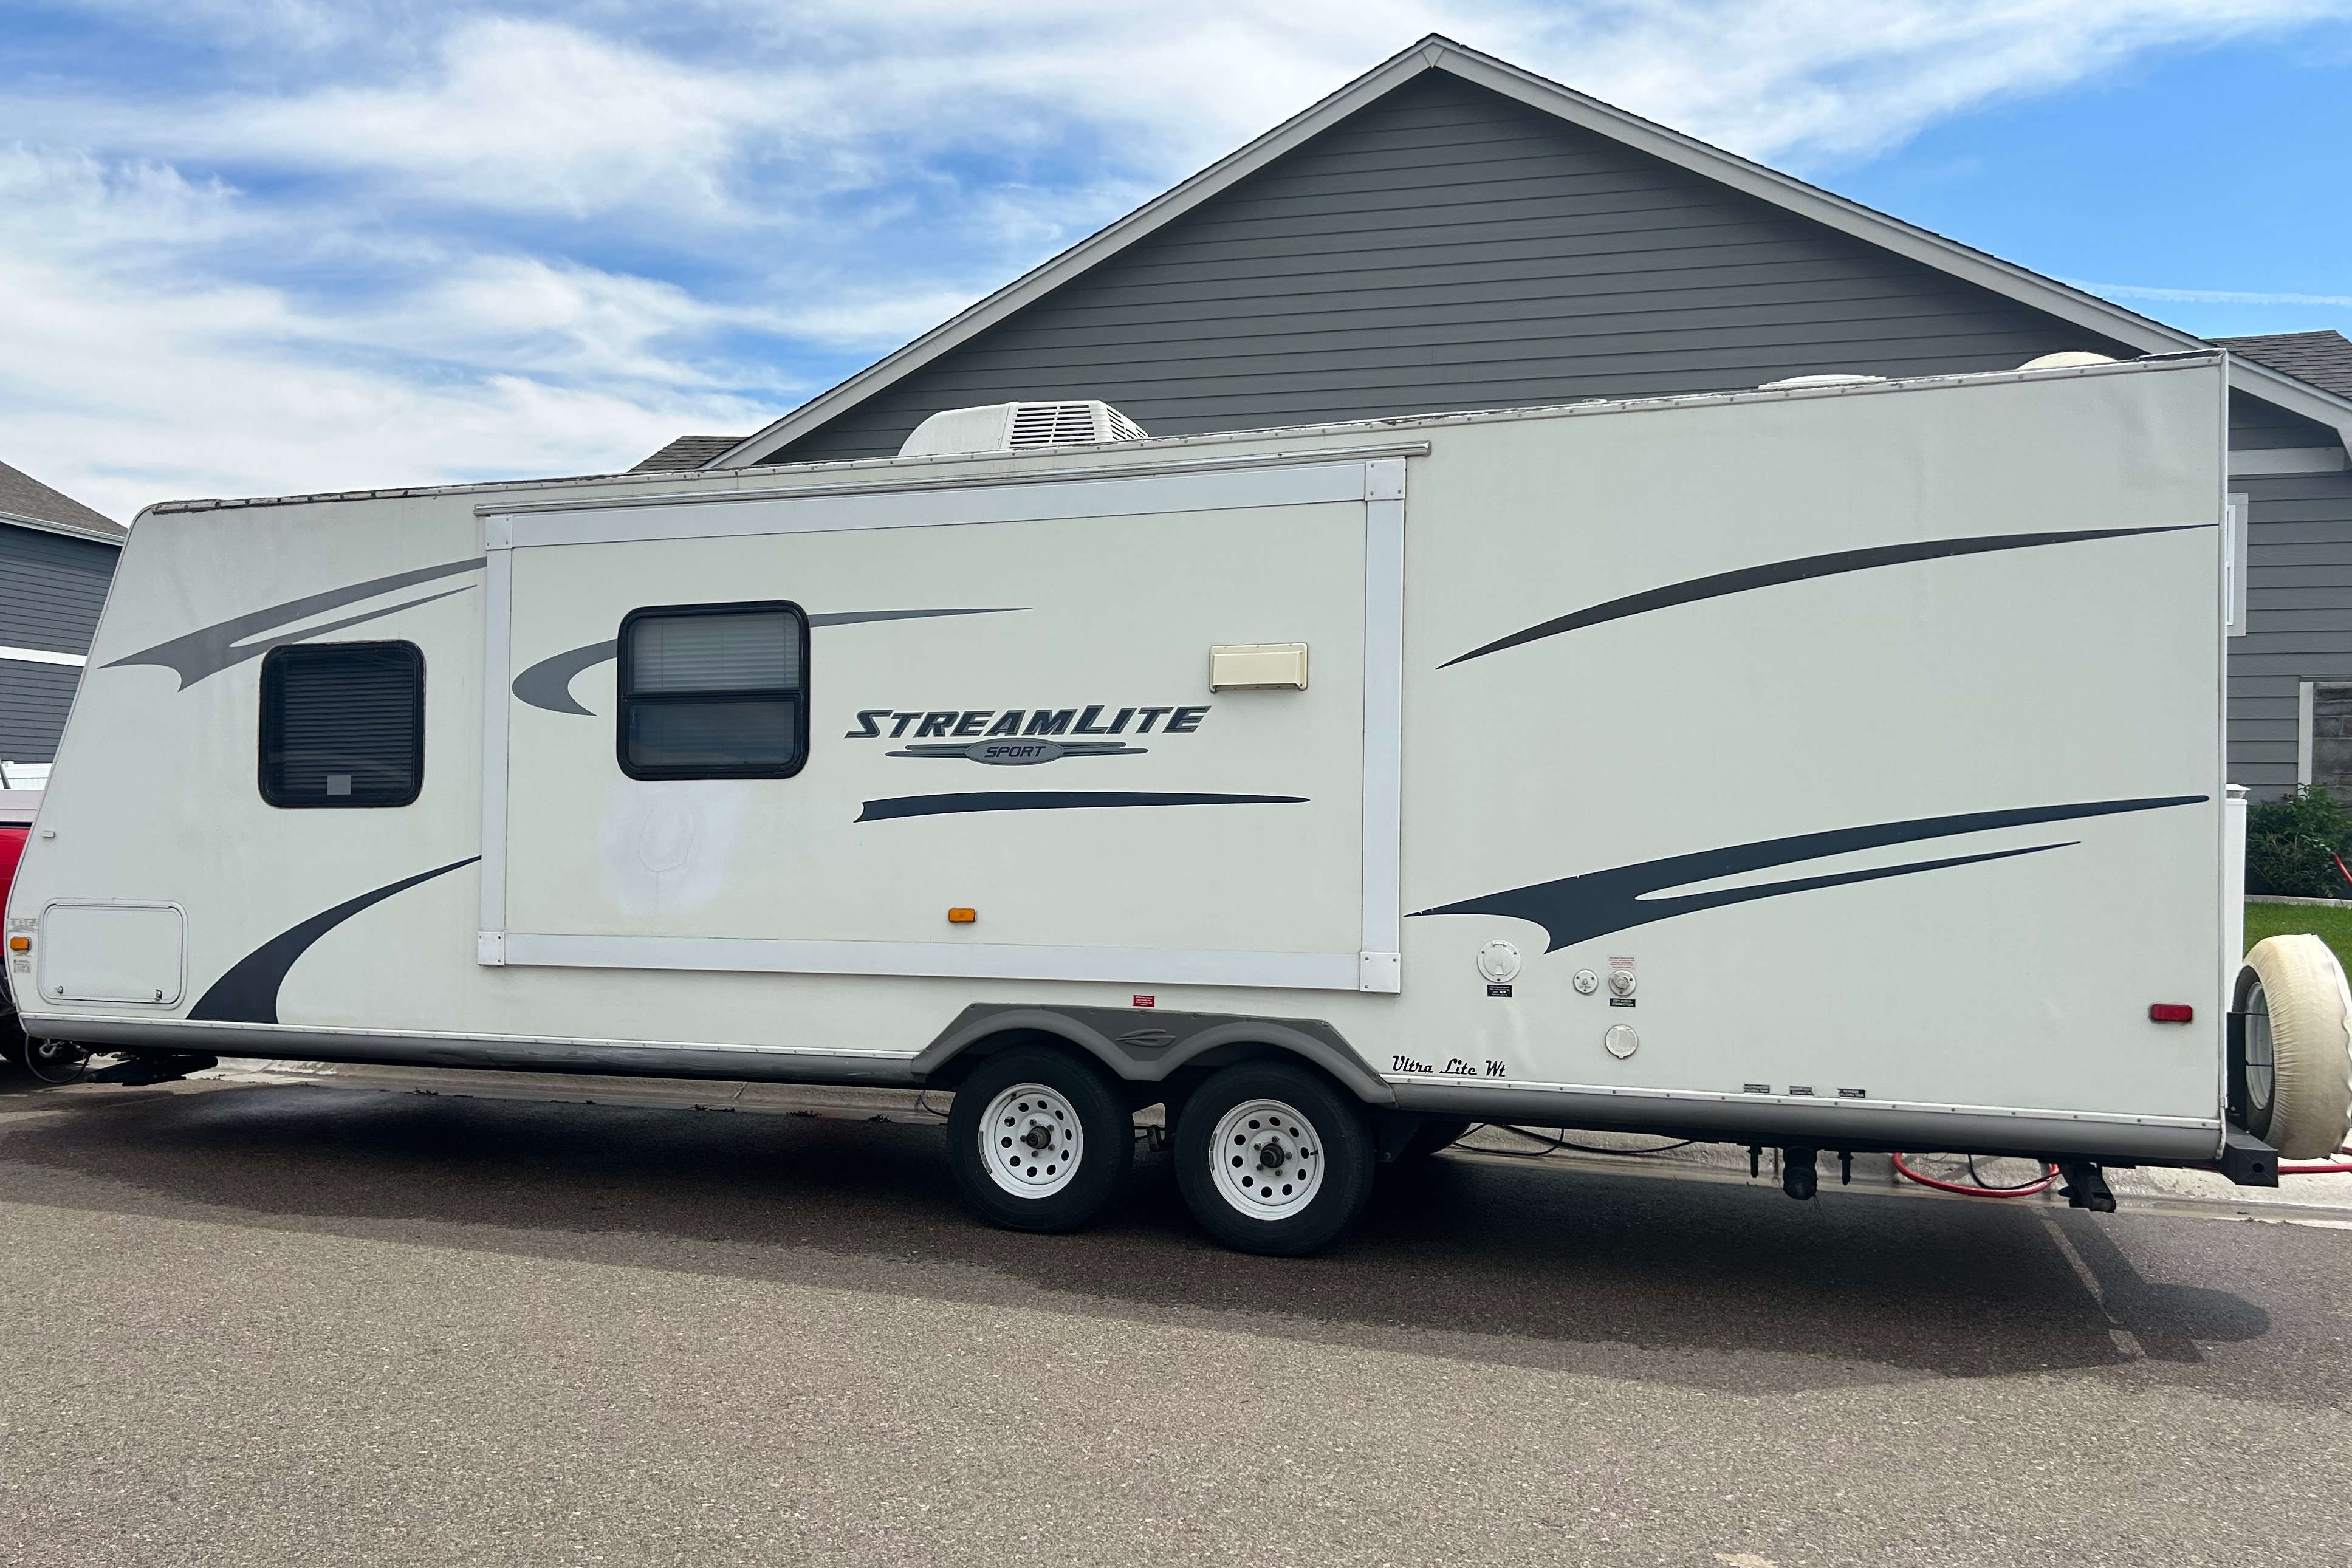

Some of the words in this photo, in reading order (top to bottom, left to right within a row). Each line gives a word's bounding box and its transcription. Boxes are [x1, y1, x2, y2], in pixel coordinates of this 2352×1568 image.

[844, 705, 1212, 739] STREAMLITE
[984, 746, 1046, 758] SPORT
[1392, 1055, 1434, 1073] Ultra
[1439, 1058, 1478, 1076] Lite
[1485, 1060, 1506, 1077] Wt
